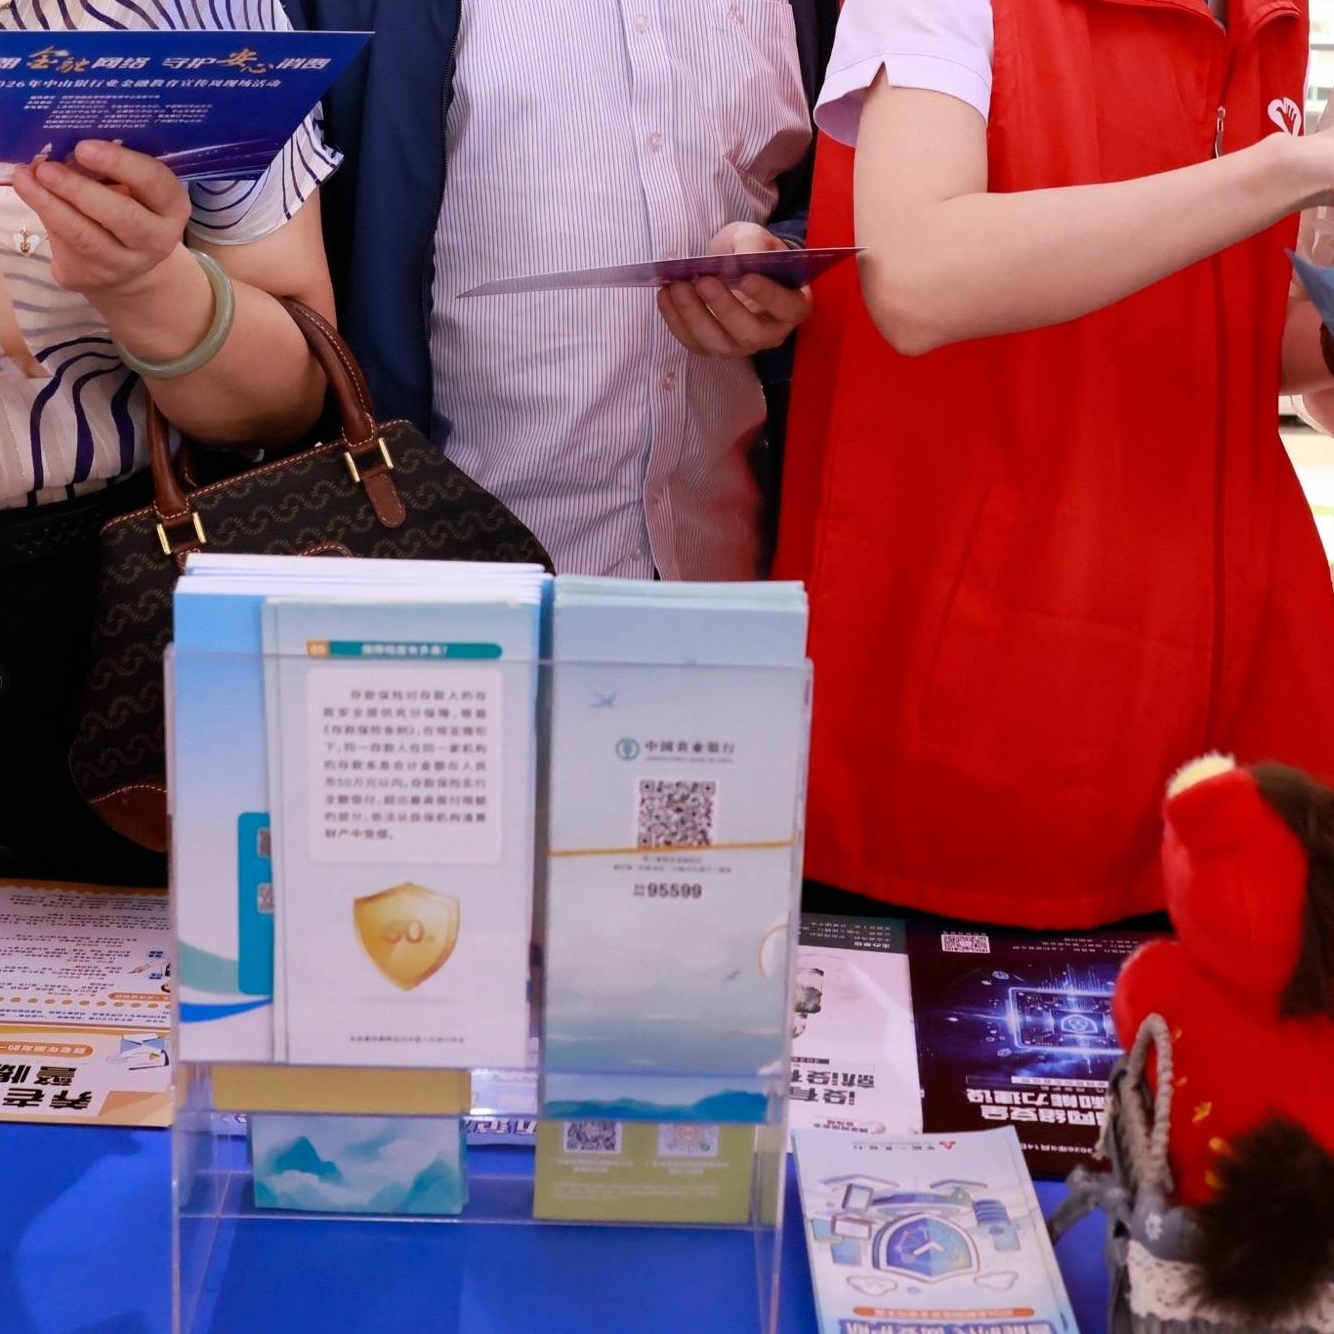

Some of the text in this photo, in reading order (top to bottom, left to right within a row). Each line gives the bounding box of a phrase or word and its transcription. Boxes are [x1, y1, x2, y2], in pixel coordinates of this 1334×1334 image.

[161, 47, 332, 74] 守护安心消费
[644, 739, 736, 755] 中国农业银行
[647, 882, 703, 899] 95599
[980, 1105, 1108, 1127] 网络安全
